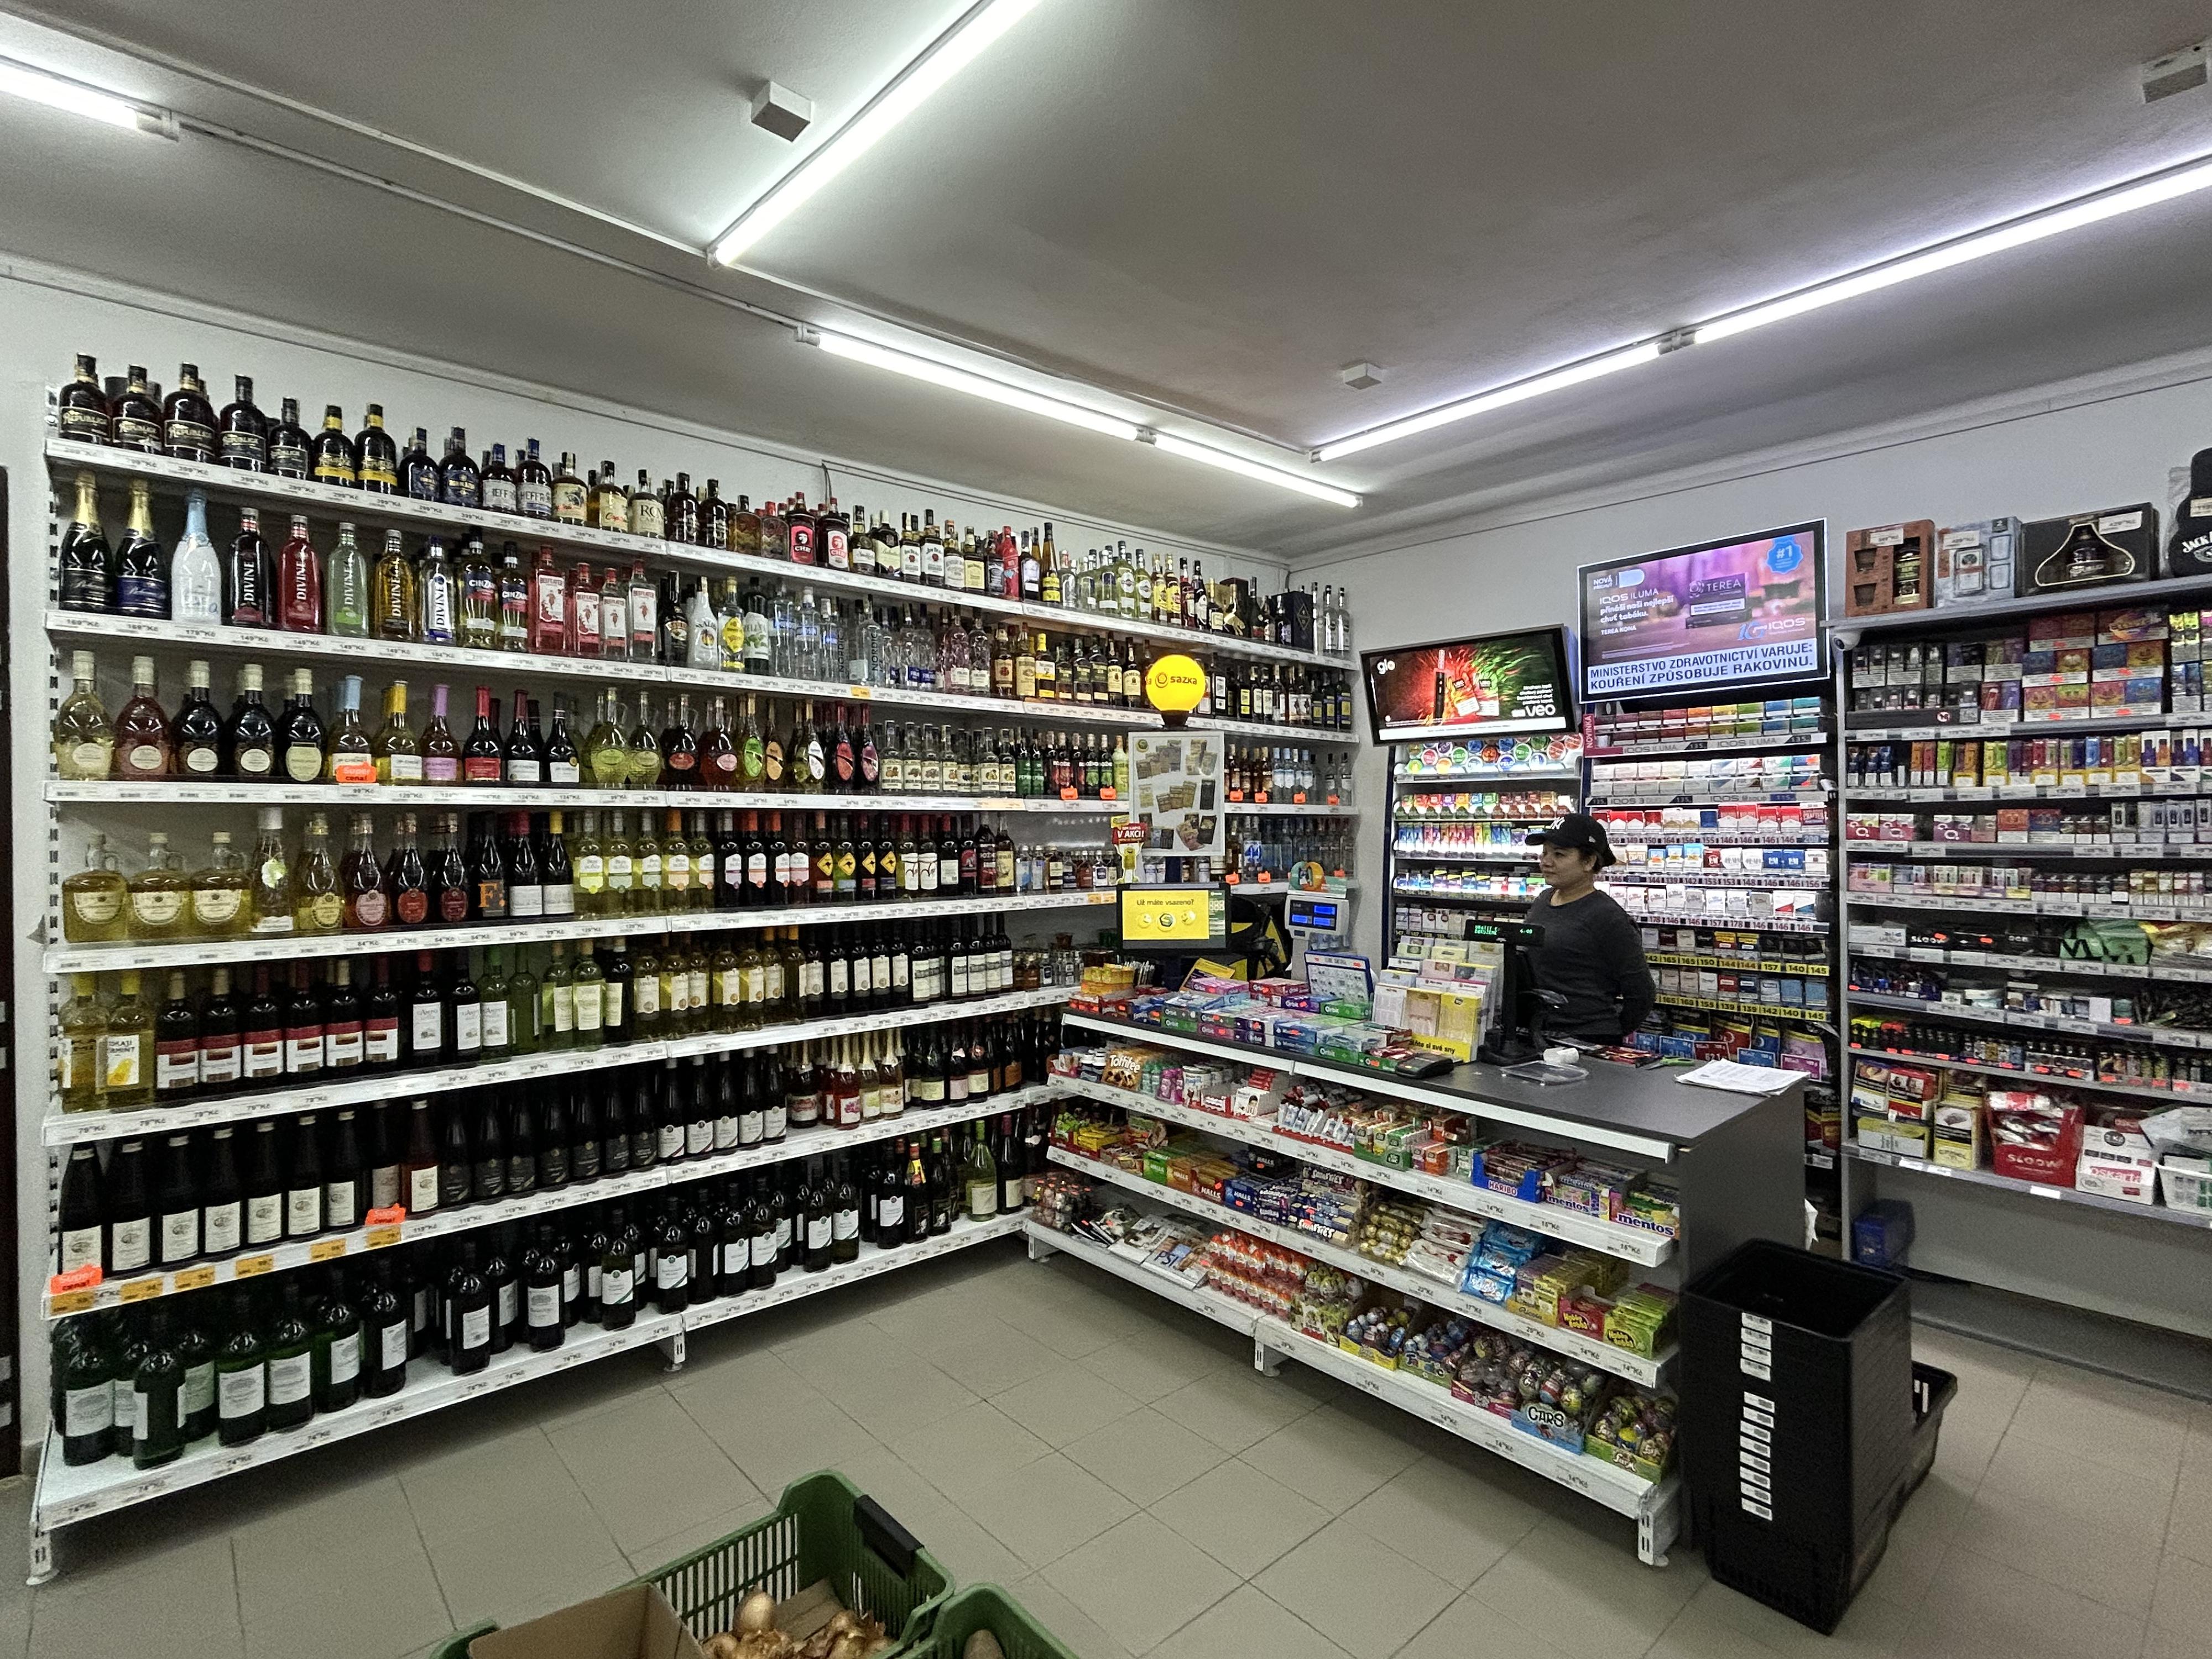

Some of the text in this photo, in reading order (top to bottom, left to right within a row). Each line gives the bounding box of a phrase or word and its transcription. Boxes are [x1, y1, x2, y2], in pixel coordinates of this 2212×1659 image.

[2181, 534, 2207, 554] JACK
[1776, 545, 1793, 560] #1
[243, 562, 254, 602] DIVINE
[296, 561, 306, 601] DIVINE
[1705, 579, 1742, 592] TEREA
[1599, 587, 1659, 605] IQOS ILUMA
[1643, 596, 1674, 609] nejlepší
[435, 585, 445, 625] DIVINE
[1768, 617, 1806, 630] IQOS
[1377, 659, 1396, 675] glo
[1590, 660, 1666, 679] MINISTERSTVO
[1670, 645, 1759, 669] ZDRAVOTNICTVÍ
[1761, 641, 1813, 658] VARUJE:
[1590, 656, 1813, 690] KOUŘENÍ ZPŮSOBUJE RAKOVINU.
[1525, 704, 1557, 716] veo
[1585, 716, 1593, 749] NOVINKA
[1624, 743, 1677, 754] IQOS ILUMA
[1717, 737, 1777, 748] IQOS ILUMA
[343, 766, 370, 776] Super
[1811, 967, 1827, 975] 145
[1783, 1009, 1798, 1017] 140
[1808, 1011, 1824, 1019] 145
[1109, 1055, 1141, 1073] Toffifee
[1201, 1187, 1221, 1201] HALLS
[1488, 1181, 1518, 1197] HARIBO
[1548, 1195, 1590, 1213] mentos
[1616, 1213, 1674, 1237] mentos
[1527, 1406, 1566, 1428] CARS
